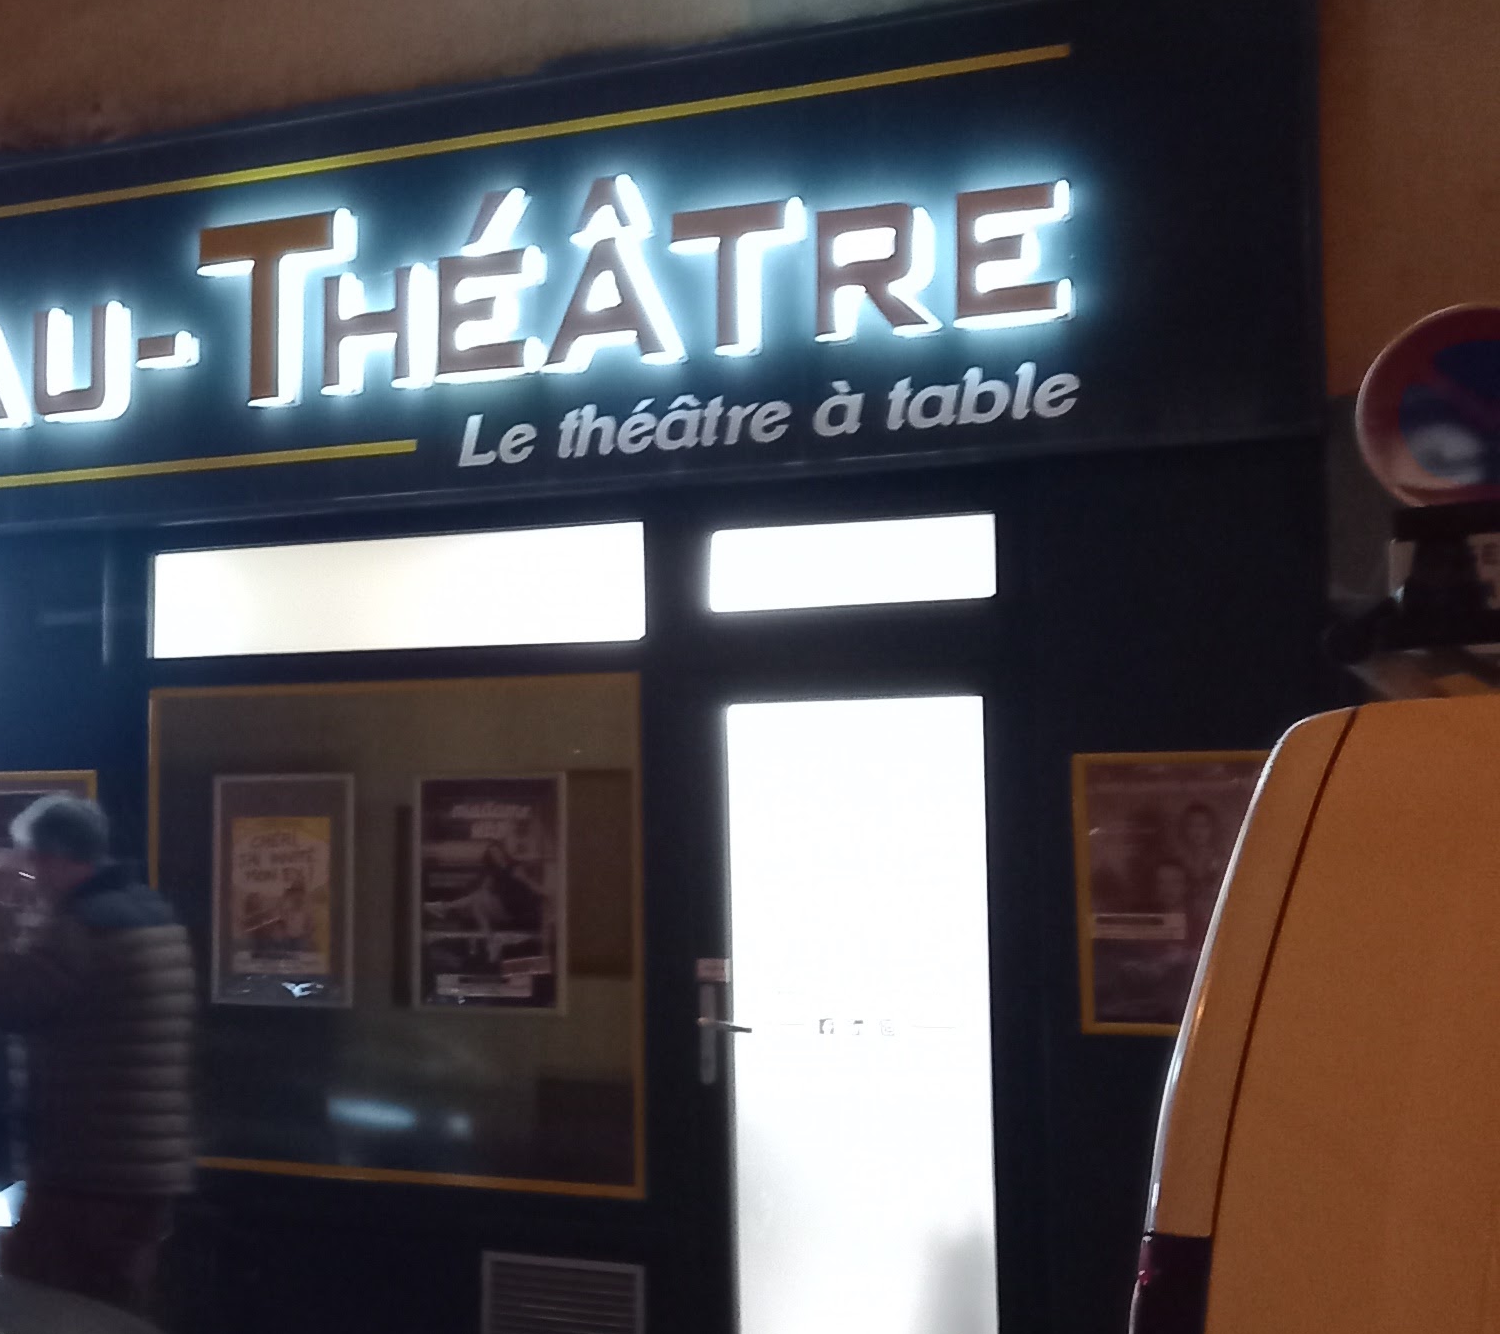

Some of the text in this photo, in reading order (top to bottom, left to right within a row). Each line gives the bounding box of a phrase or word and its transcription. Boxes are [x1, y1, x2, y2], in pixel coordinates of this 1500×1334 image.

[458, 359, 1082, 468] Le théâtre à table
